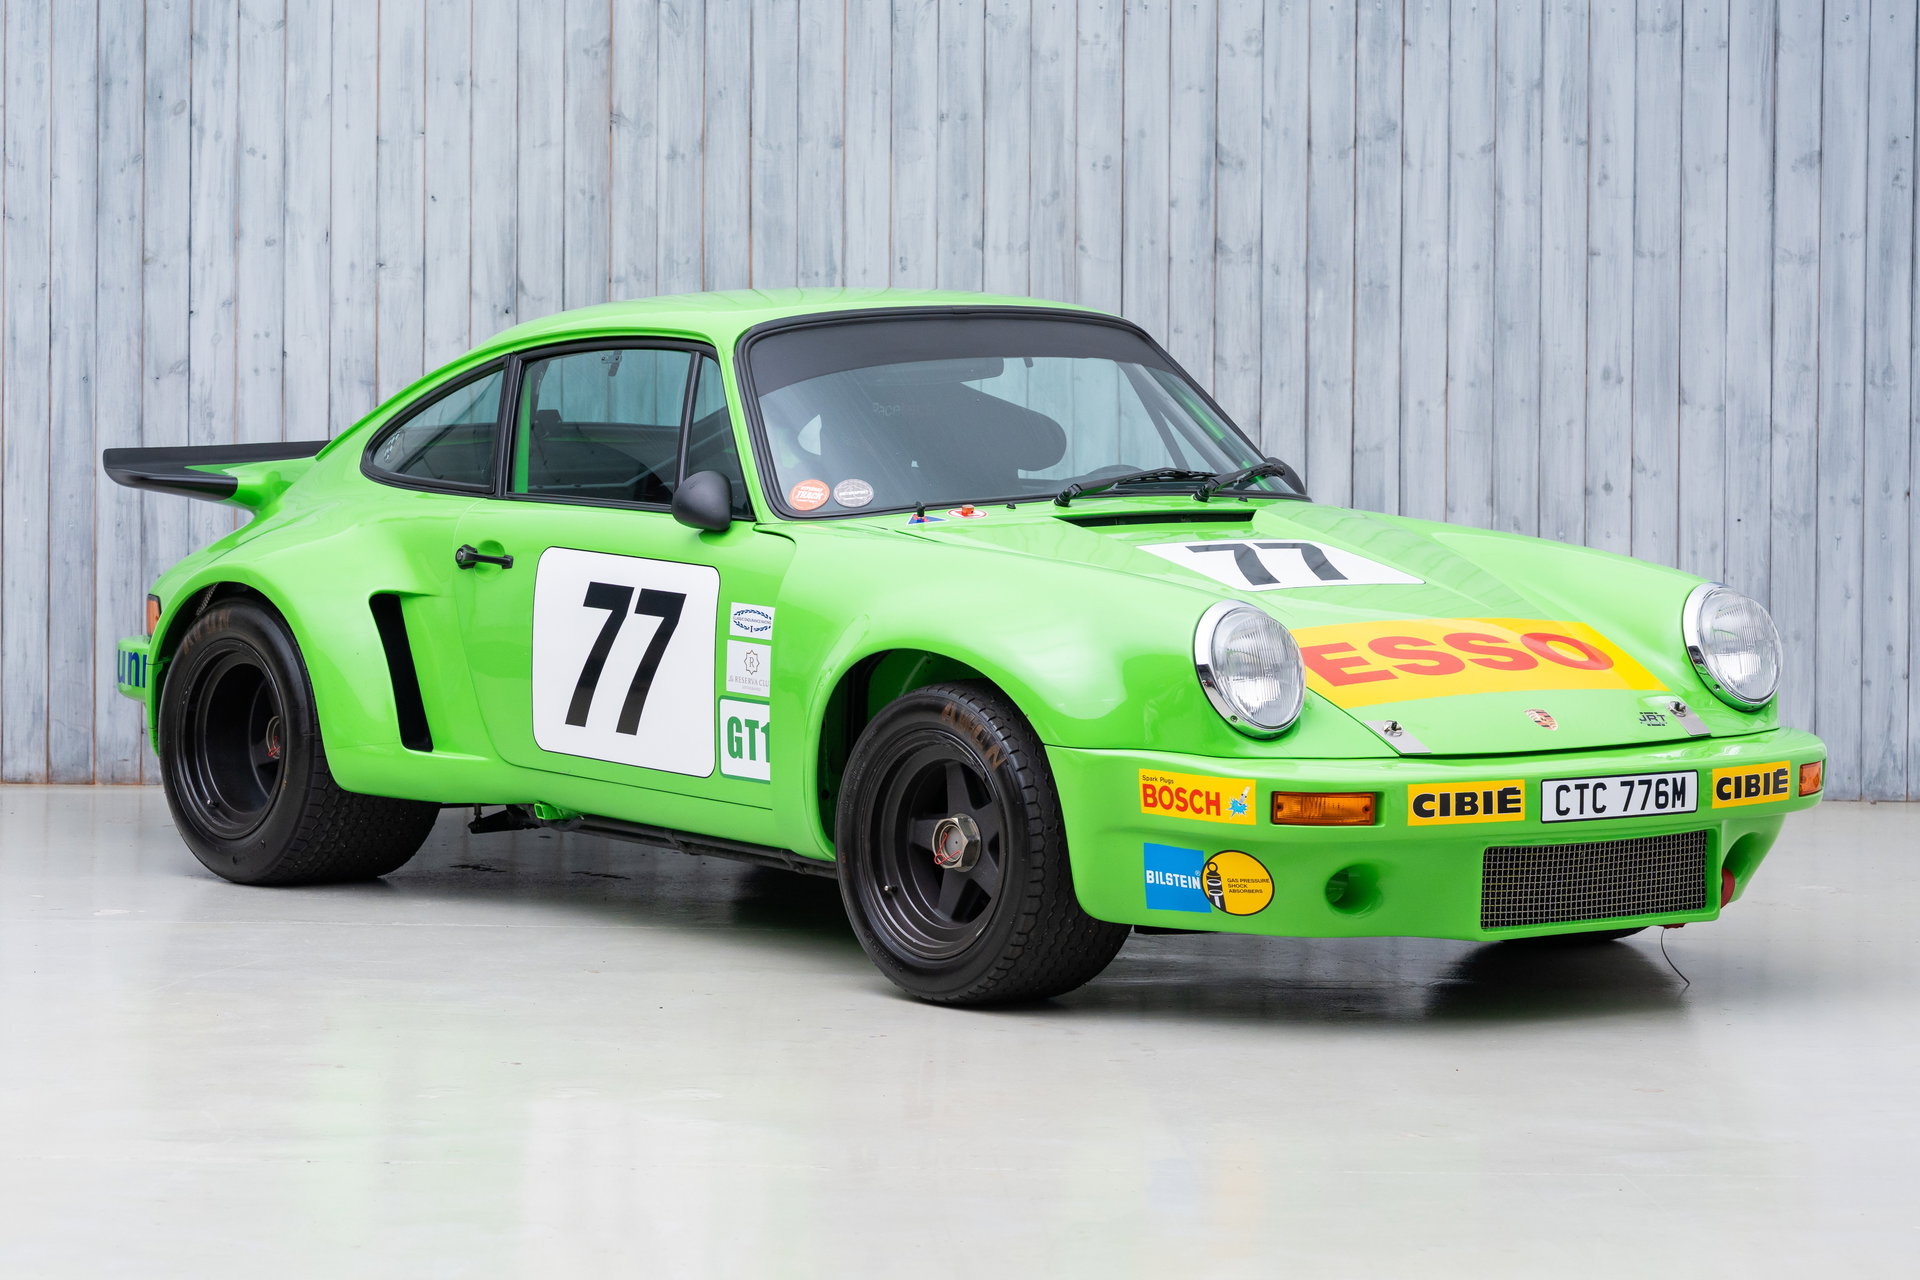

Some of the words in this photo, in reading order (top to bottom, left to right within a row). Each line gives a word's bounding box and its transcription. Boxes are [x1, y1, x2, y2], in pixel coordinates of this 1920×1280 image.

[1185, 543, 1348, 586] 77
[565, 581, 687, 736] 77
[1300, 632, 1614, 687] ESSO
[727, 716, 770, 763] GT1
[1160, 776, 1174, 785] Plugs
[1555, 782, 1607, 817] CTC
[1620, 776, 1686, 812] 776M
[1716, 768, 1788, 801] CIBIÉ
[1142, 783, 1221, 817] BOSCH
[1412, 787, 1521, 818] CIBIÉ
[1145, 869, 1201, 890] BILSTEIN
